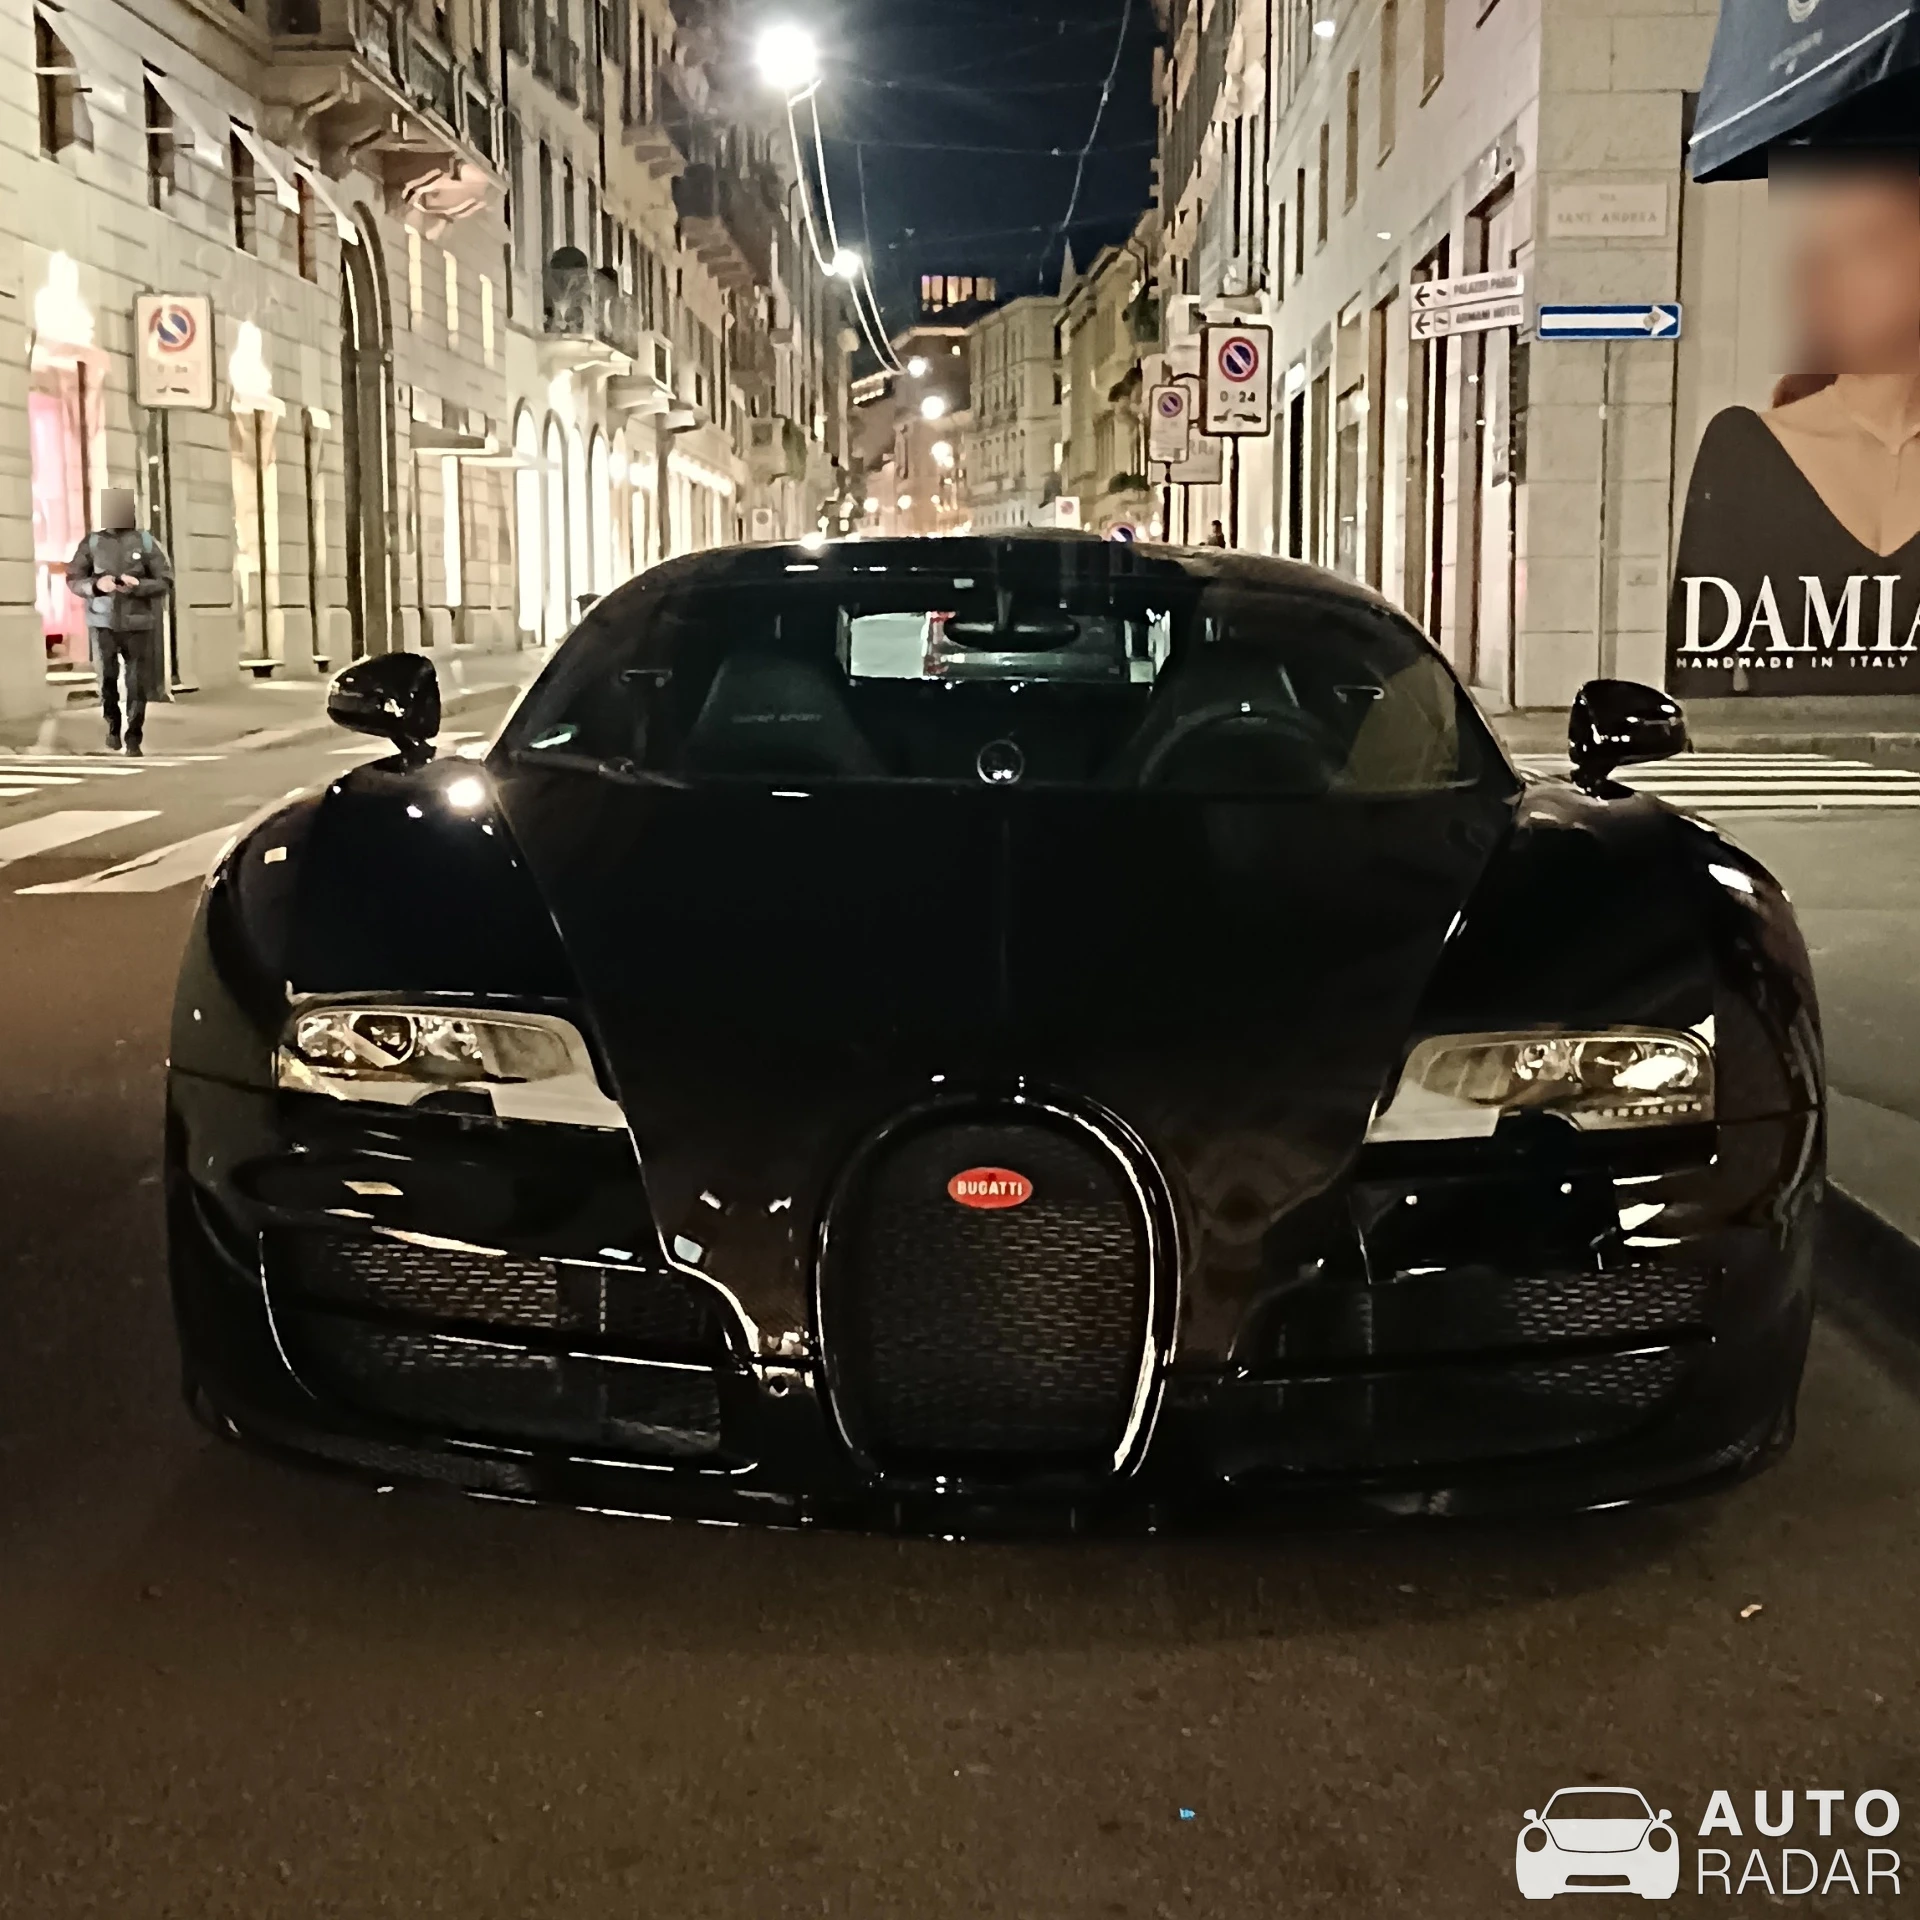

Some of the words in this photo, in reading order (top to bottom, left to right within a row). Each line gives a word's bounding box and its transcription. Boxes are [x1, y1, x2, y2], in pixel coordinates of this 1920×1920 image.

[1238, 390, 1256, 403] 24
[1676, 656, 1795, 669] HANDMADE
[1811, 656, 1833, 668] IN
[1850, 655, 1908, 668] ITALY
[957, 1180, 1023, 1196] BUGATTI
